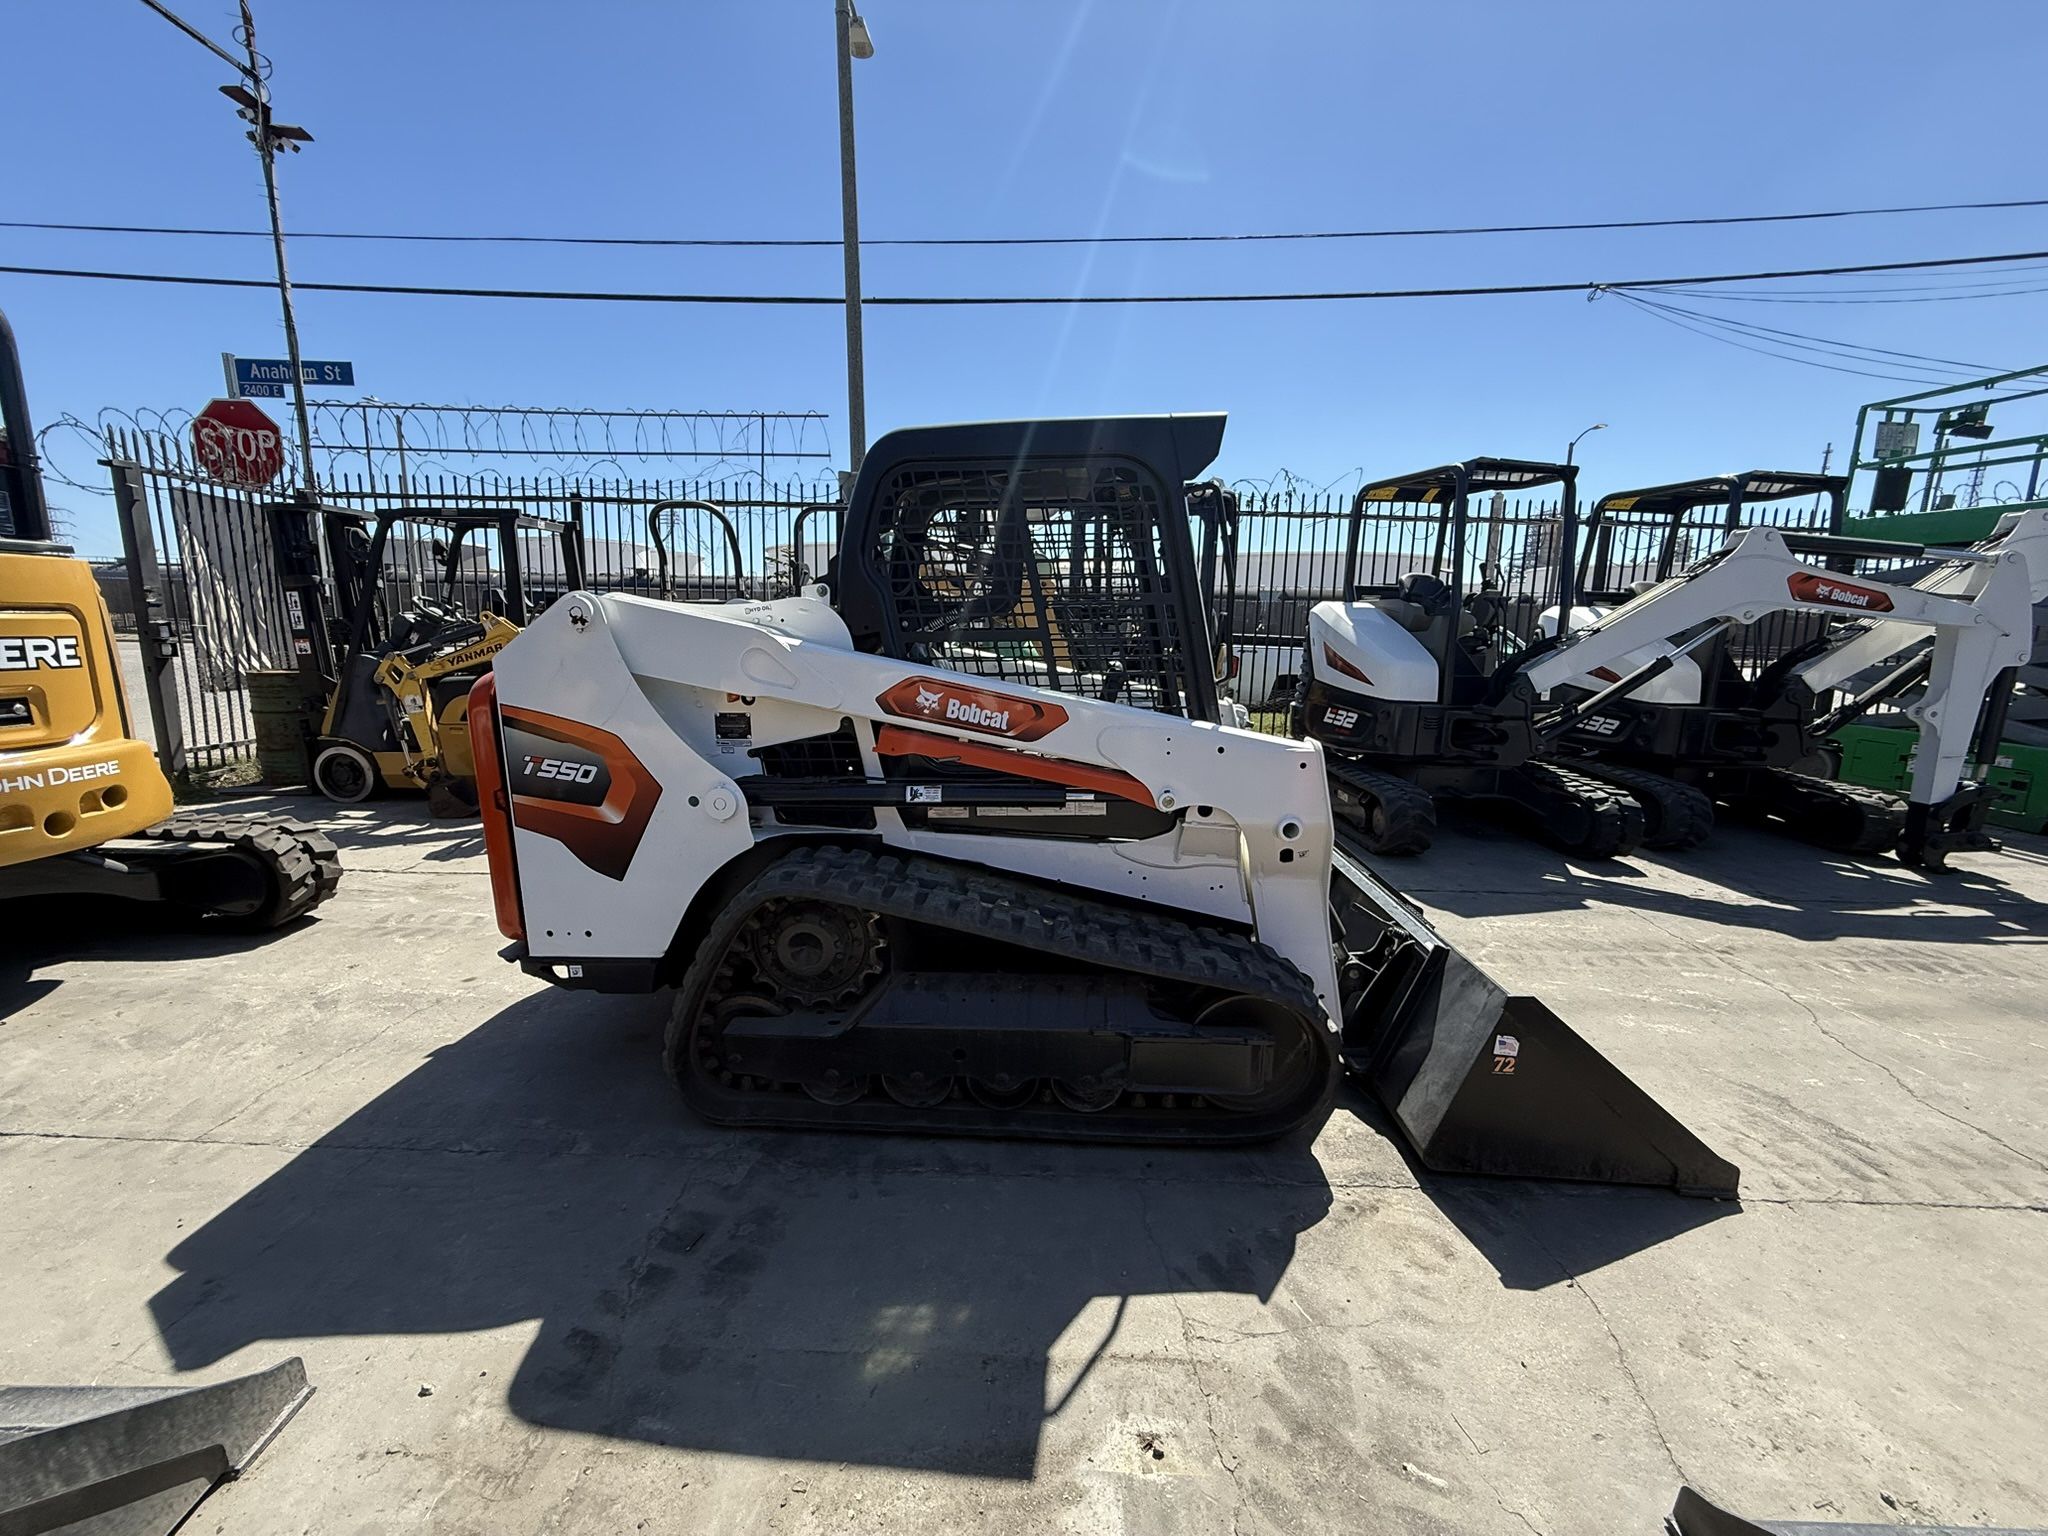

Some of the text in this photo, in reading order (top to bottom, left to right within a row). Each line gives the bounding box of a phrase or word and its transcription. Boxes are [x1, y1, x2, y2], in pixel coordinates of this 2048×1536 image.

[250, 362, 342, 381] Anahm St
[243, 384, 280, 397] 2400 E
[200, 427, 275, 462] STOP
[1831, 588, 1869, 606] Bobcat
[447, 643, 503, 666] YANMAR
[946, 697, 1009, 730] Bobcat
[1322, 706, 1359, 729] E32
[0, 760, 121, 793] HN DEERE
[523, 755, 598, 784] T550
[1494, 1056, 1516, 1073] 72
